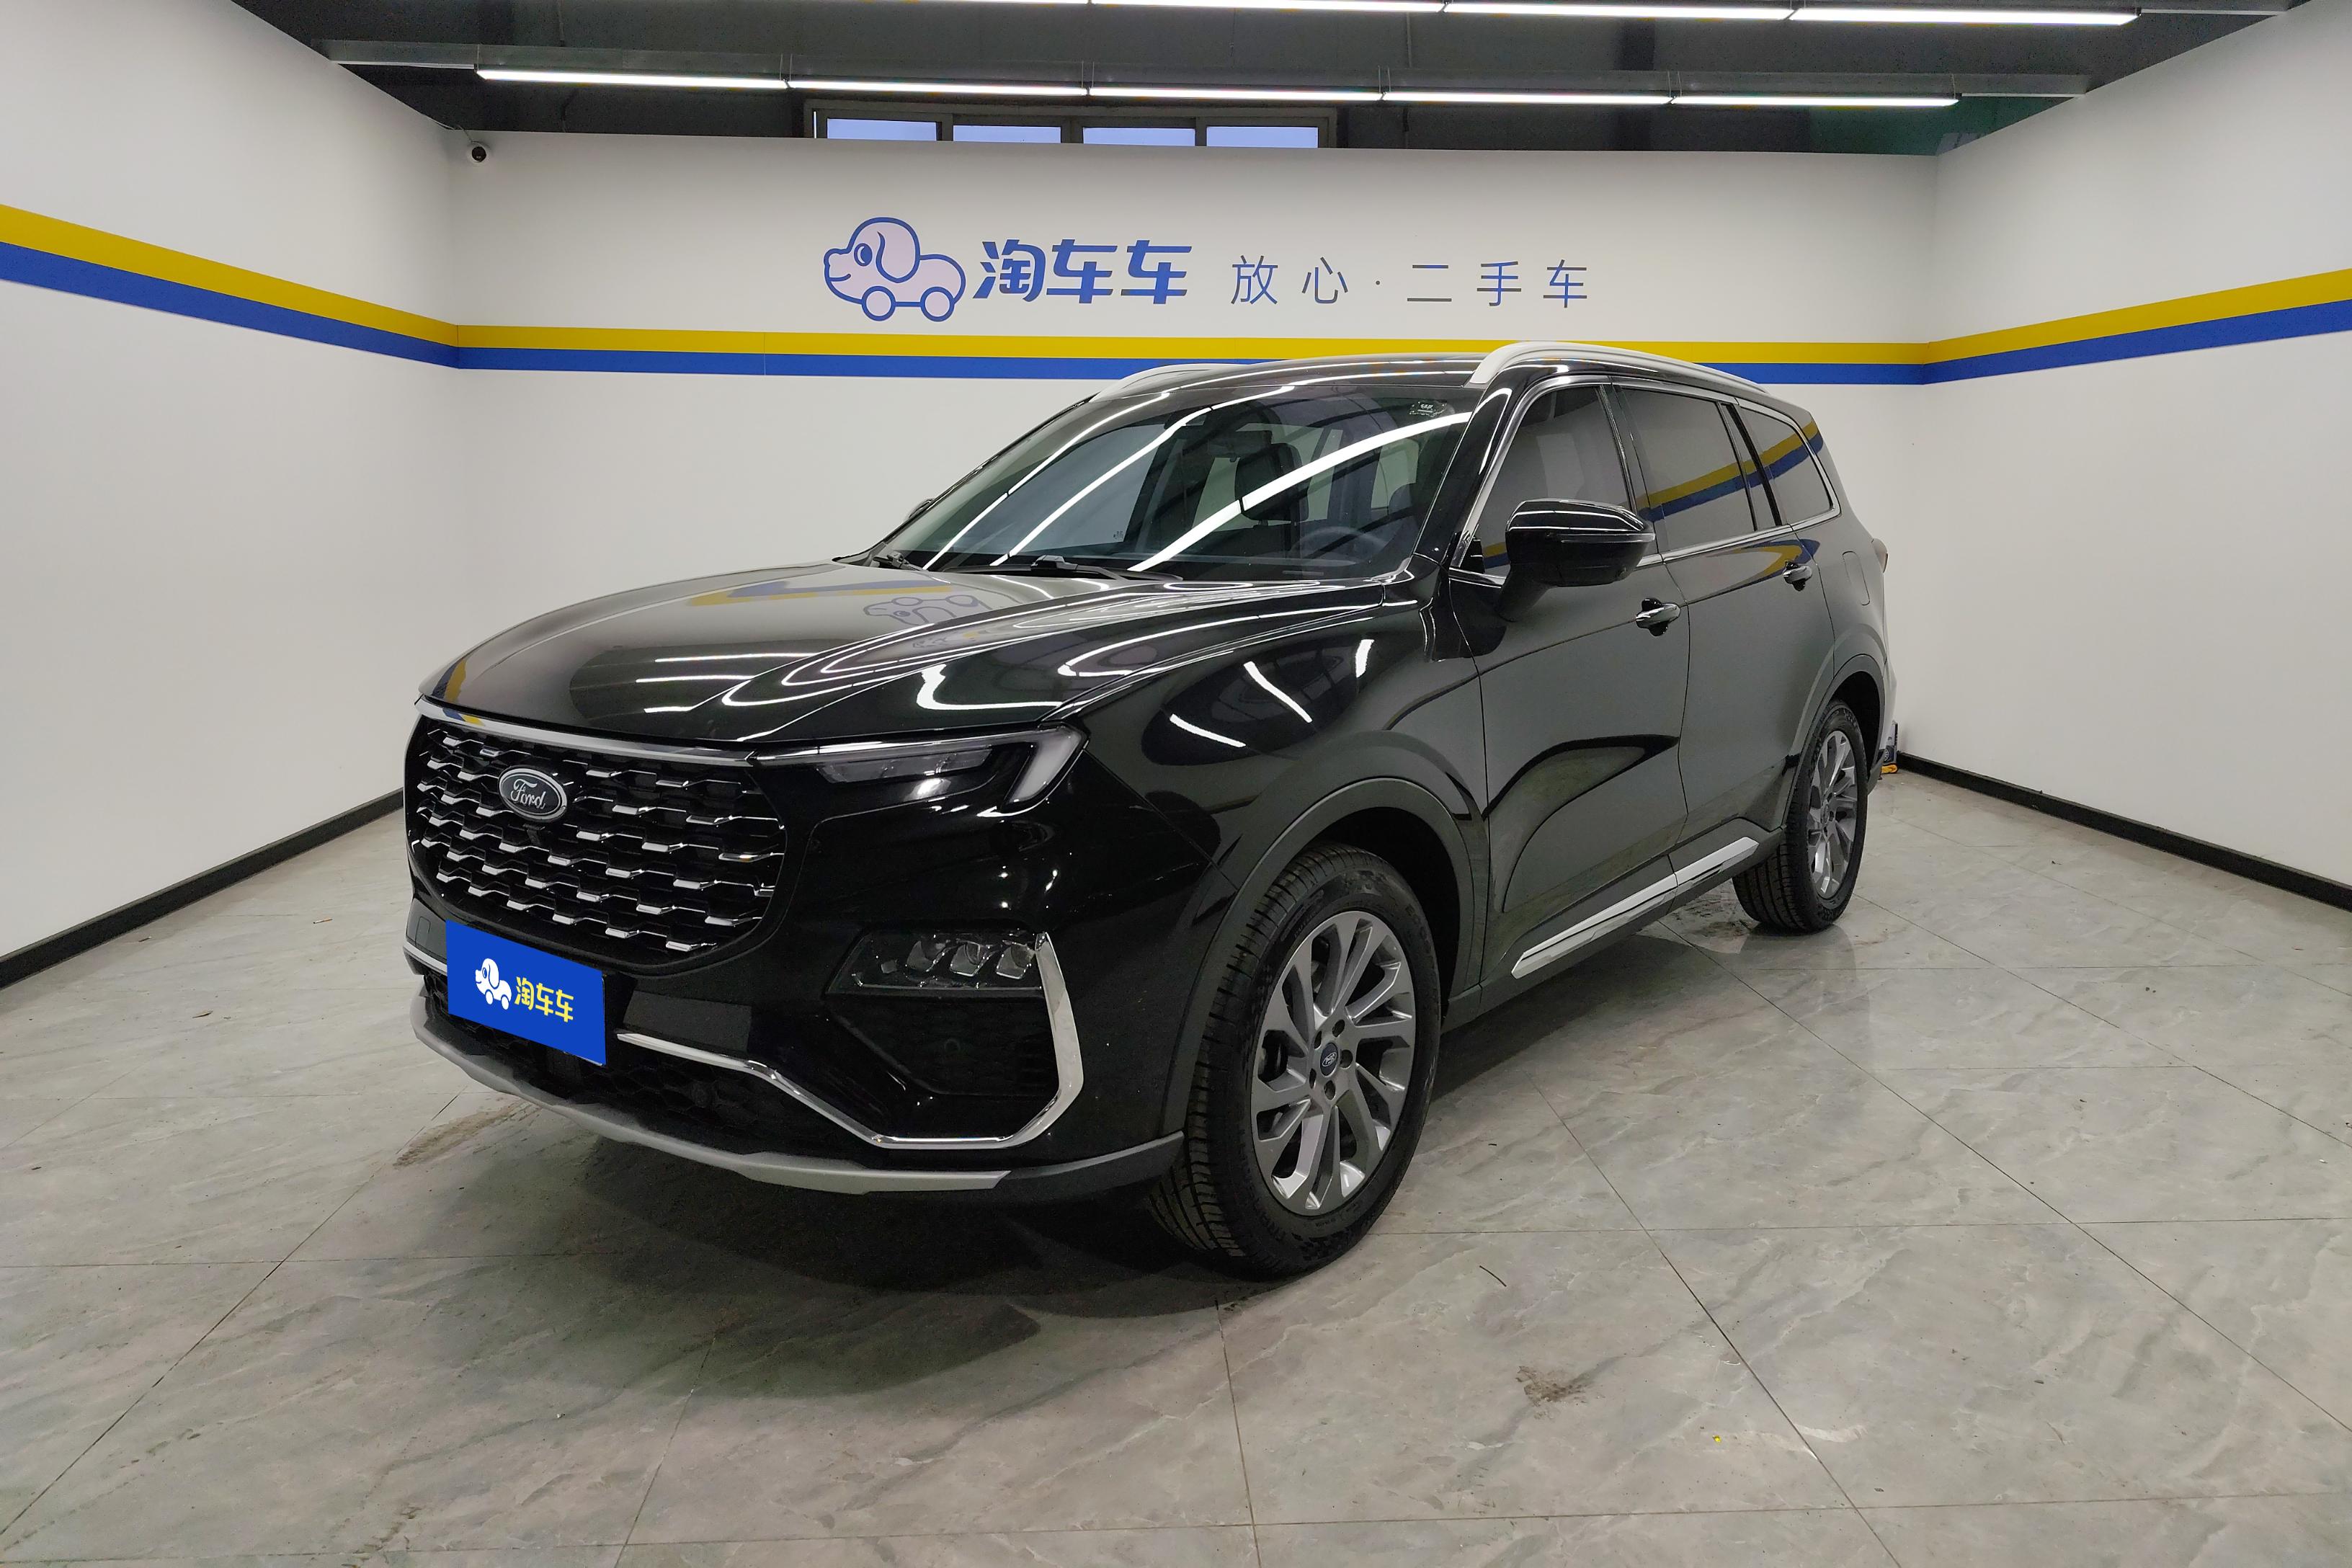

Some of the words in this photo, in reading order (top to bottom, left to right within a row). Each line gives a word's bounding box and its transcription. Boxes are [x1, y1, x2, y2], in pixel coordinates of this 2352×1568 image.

[973, 239, 1193, 305] 淘车车
[510, 778, 546, 809] Ford
